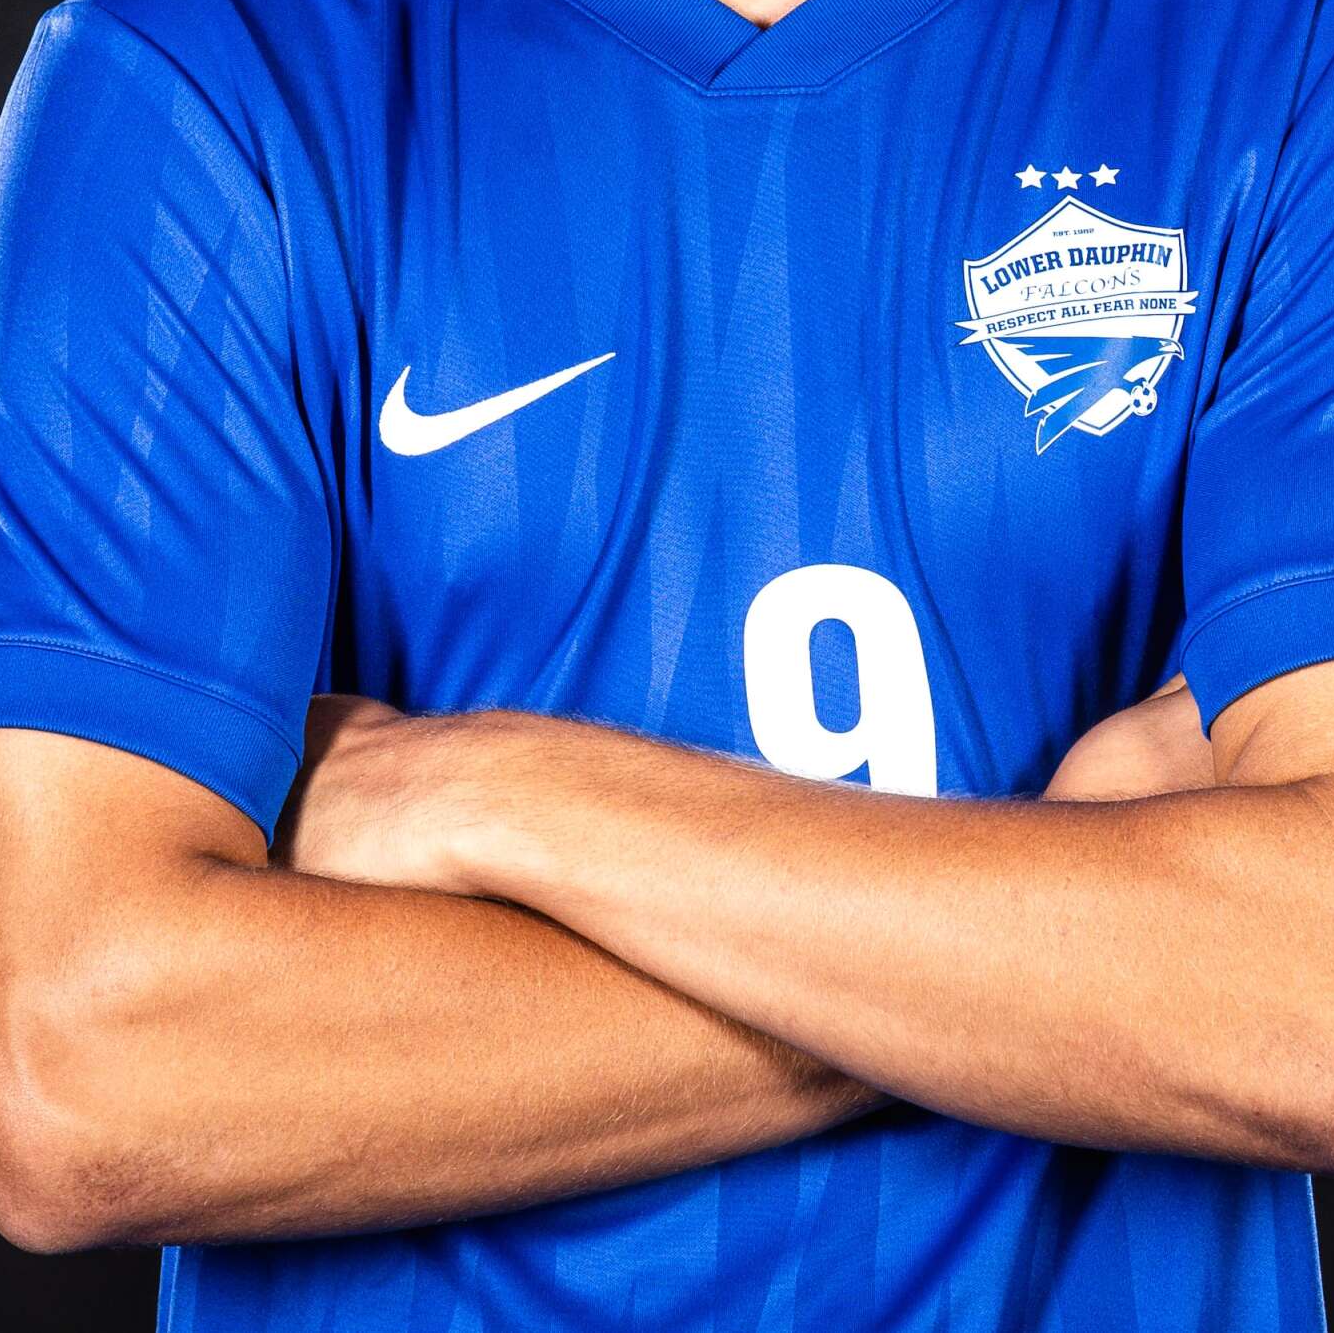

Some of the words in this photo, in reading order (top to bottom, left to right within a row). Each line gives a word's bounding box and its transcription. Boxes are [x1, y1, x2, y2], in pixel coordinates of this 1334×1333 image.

[980, 250, 1063, 295] LOWER
[1068, 243, 1173, 268] DAUPHIN
[1020, 267, 1141, 301] FALCONS
[986, 310, 1056, 334] RESPECT
[1061, 305, 1089, 318] ALL
[1094, 299, 1134, 313] FEAR
[1139, 298, 1177, 310] NONE
[744, 564, 937, 798] 9
